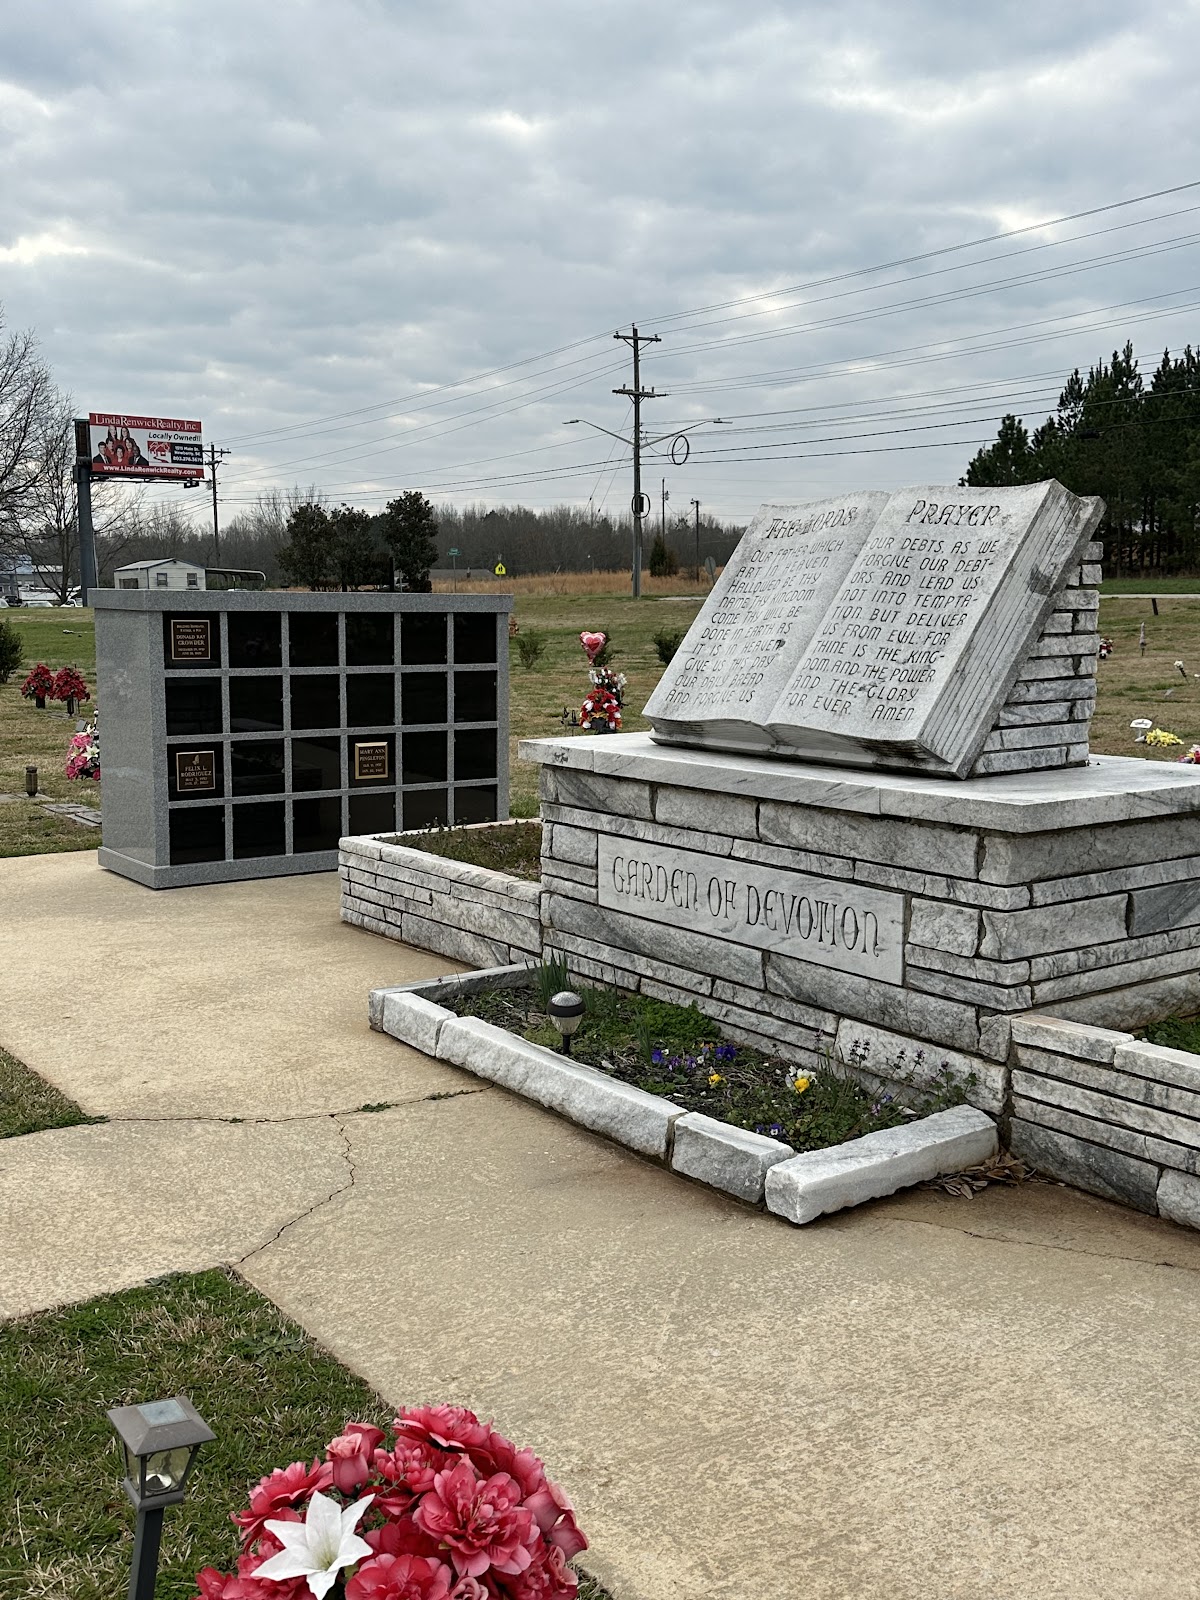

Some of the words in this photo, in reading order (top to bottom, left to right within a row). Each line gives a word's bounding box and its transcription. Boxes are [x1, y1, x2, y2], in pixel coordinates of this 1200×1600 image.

[184, 421, 199, 431] Inc.
[149, 432, 172, 441] Locally
[103, 465, 197, 476] www.LindaRenwickRealty.com
[905, 499, 1001, 527] PRAYER
[766, 518, 801, 539] THE
[751, 550, 774, 563] OUR
[773, 544, 808, 564] FATHER
[809, 540, 844, 554] WHICH
[870, 537, 894, 550] OUR
[951, 541, 971, 554] AS
[978, 540, 1000, 554] WE
[736, 567, 762, 578] ART
[766, 565, 779, 577] IN
[860, 554, 913, 569] FORGIVE
[919, 557, 949, 572] OUR
[954, 559, 994, 573] DEBT-
[728, 579, 781, 594] HALLOWED
[782, 576, 796, 588] BE
[799, 573, 822, 585] THY
[880, 571, 911, 587] AND
[919, 576, 954, 590] LEAD
[962, 576, 981, 590] US
[719, 596, 750, 609] NAME
[751, 595, 771, 609] THY
[770, 589, 816, 603] KINGDOM
[840, 588, 867, 602] NOT
[871, 590, 907, 606] INTO
[914, 594, 979, 609] TEMPTA-
[743, 611, 762, 624] THY
[763, 609, 782, 620] WILL
[787, 606, 803, 617] BE
[869, 608, 900, 624] BUT
[906, 612, 968, 627] DELIVER
[701, 627, 731, 640] DONE
[731, 628, 744, 641] IN
[744, 624, 773, 639] EARTH
[777, 622, 793, 634] AS
[822, 623, 839, 635] US
[842, 623, 882, 641] FROM
[923, 632, 951, 646] FOR
[692, 644, 705, 655] IT
[709, 644, 722, 656] IS
[725, 643, 738, 656] IN
[812, 640, 848, 655] THINE
[852, 643, 868, 658] IS
[876, 646, 902, 662] THE
[907, 650, 945, 664] KING-
[684, 657, 710, 672] GIVE
[712, 660, 726, 672] US
[728, 657, 749, 674] THIS
[750, 655, 775, 669] DAY
[831, 660, 860, 676] AND
[862, 664, 888, 680] THE
[674, 675, 698, 688] OUR
[700, 675, 729, 690] DAILY
[729, 673, 764, 688] BREAD
[791, 675, 821, 690] AND
[867, 684, 919, 702] GLORY
[665, 689, 690, 704] AND
[693, 691, 736, 707] FORGIVE
[739, 690, 755, 703] US
[782, 692, 808, 707] FOR
[612, 856, 698, 912] GARDEN
[707, 876, 737, 920] OF
[746, 884, 880, 958] DEVOTION
